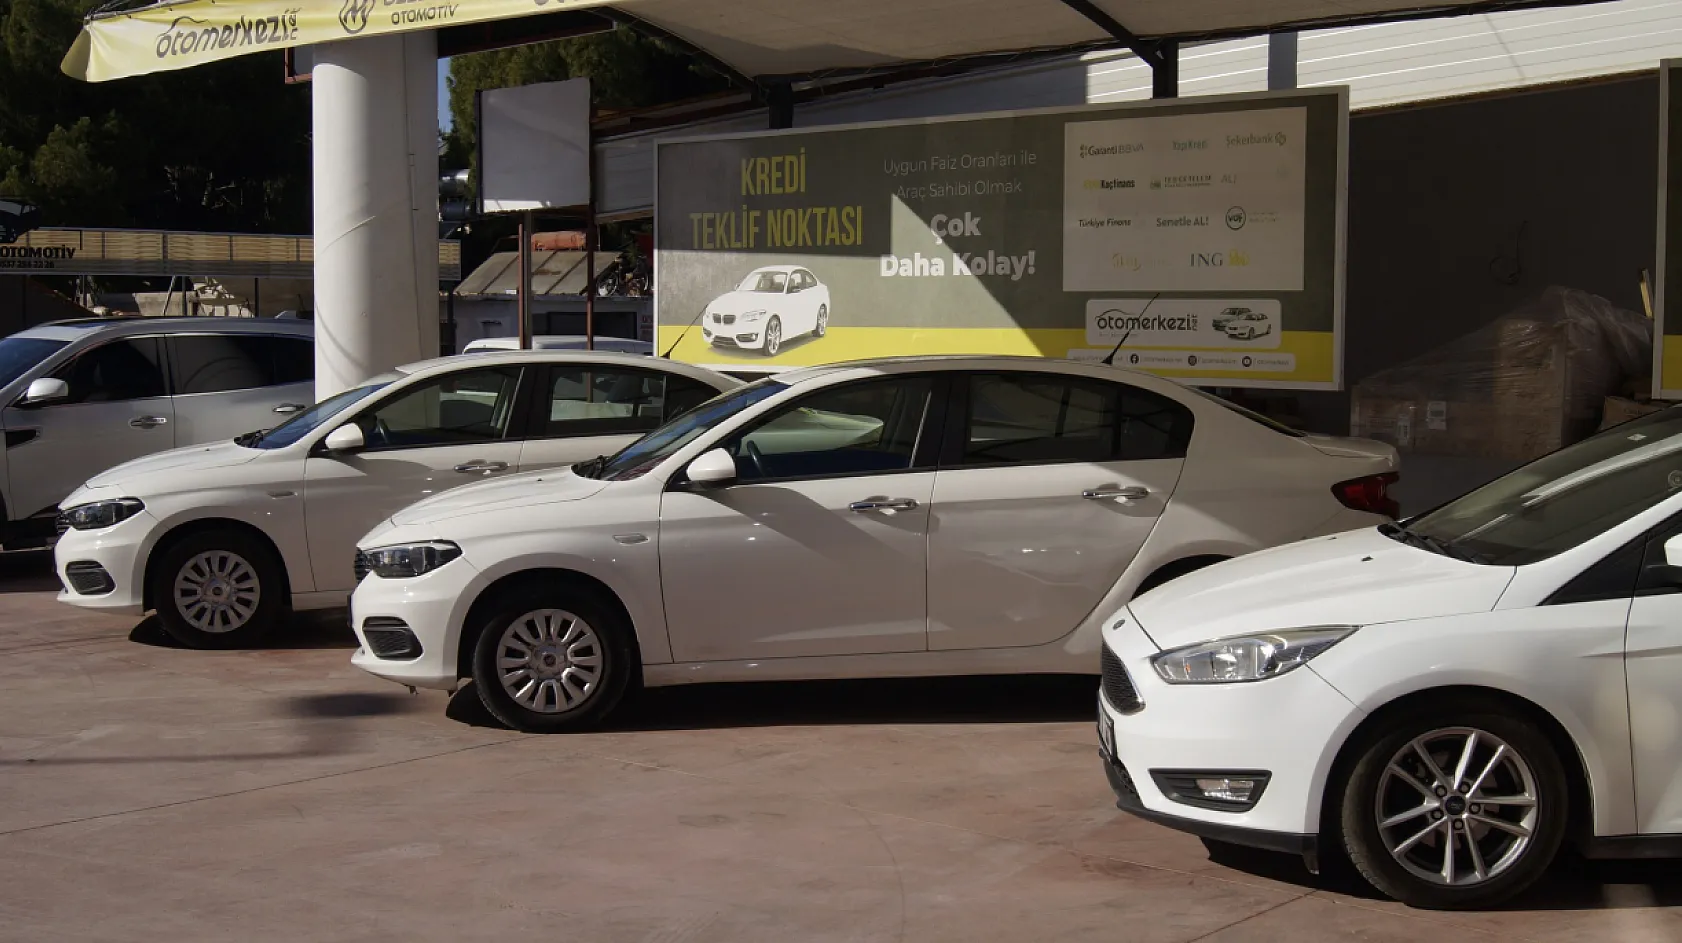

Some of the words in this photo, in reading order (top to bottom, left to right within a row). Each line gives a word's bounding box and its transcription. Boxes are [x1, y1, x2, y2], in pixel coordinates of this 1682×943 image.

[391, 3, 459, 25] OTOMOTİV
[156, 9, 288, 58] otomerkezi
[740, 147, 806, 197] KREDİ
[884, 159, 927, 176] Uygun
[930, 156, 956, 171] Faiz
[960, 152, 1016, 169] Oranları
[1021, 150, 1037, 165] ile
[896, 186, 926, 201] Araç
[929, 181, 970, 198] Sahibi
[974, 178, 1023, 195] Olmak
[690, 205, 760, 250] TEKLİF
[766, 205, 863, 248] NOKTASI
[930, 212, 982, 245] Çok
[1, 245, 77, 259] OTOMOTİV
[1190, 252, 1224, 267] ING
[879, 252, 945, 277] Daha
[952, 250, 1036, 281] Kolay!
[1097, 313, 1191, 331] otomerkezi
